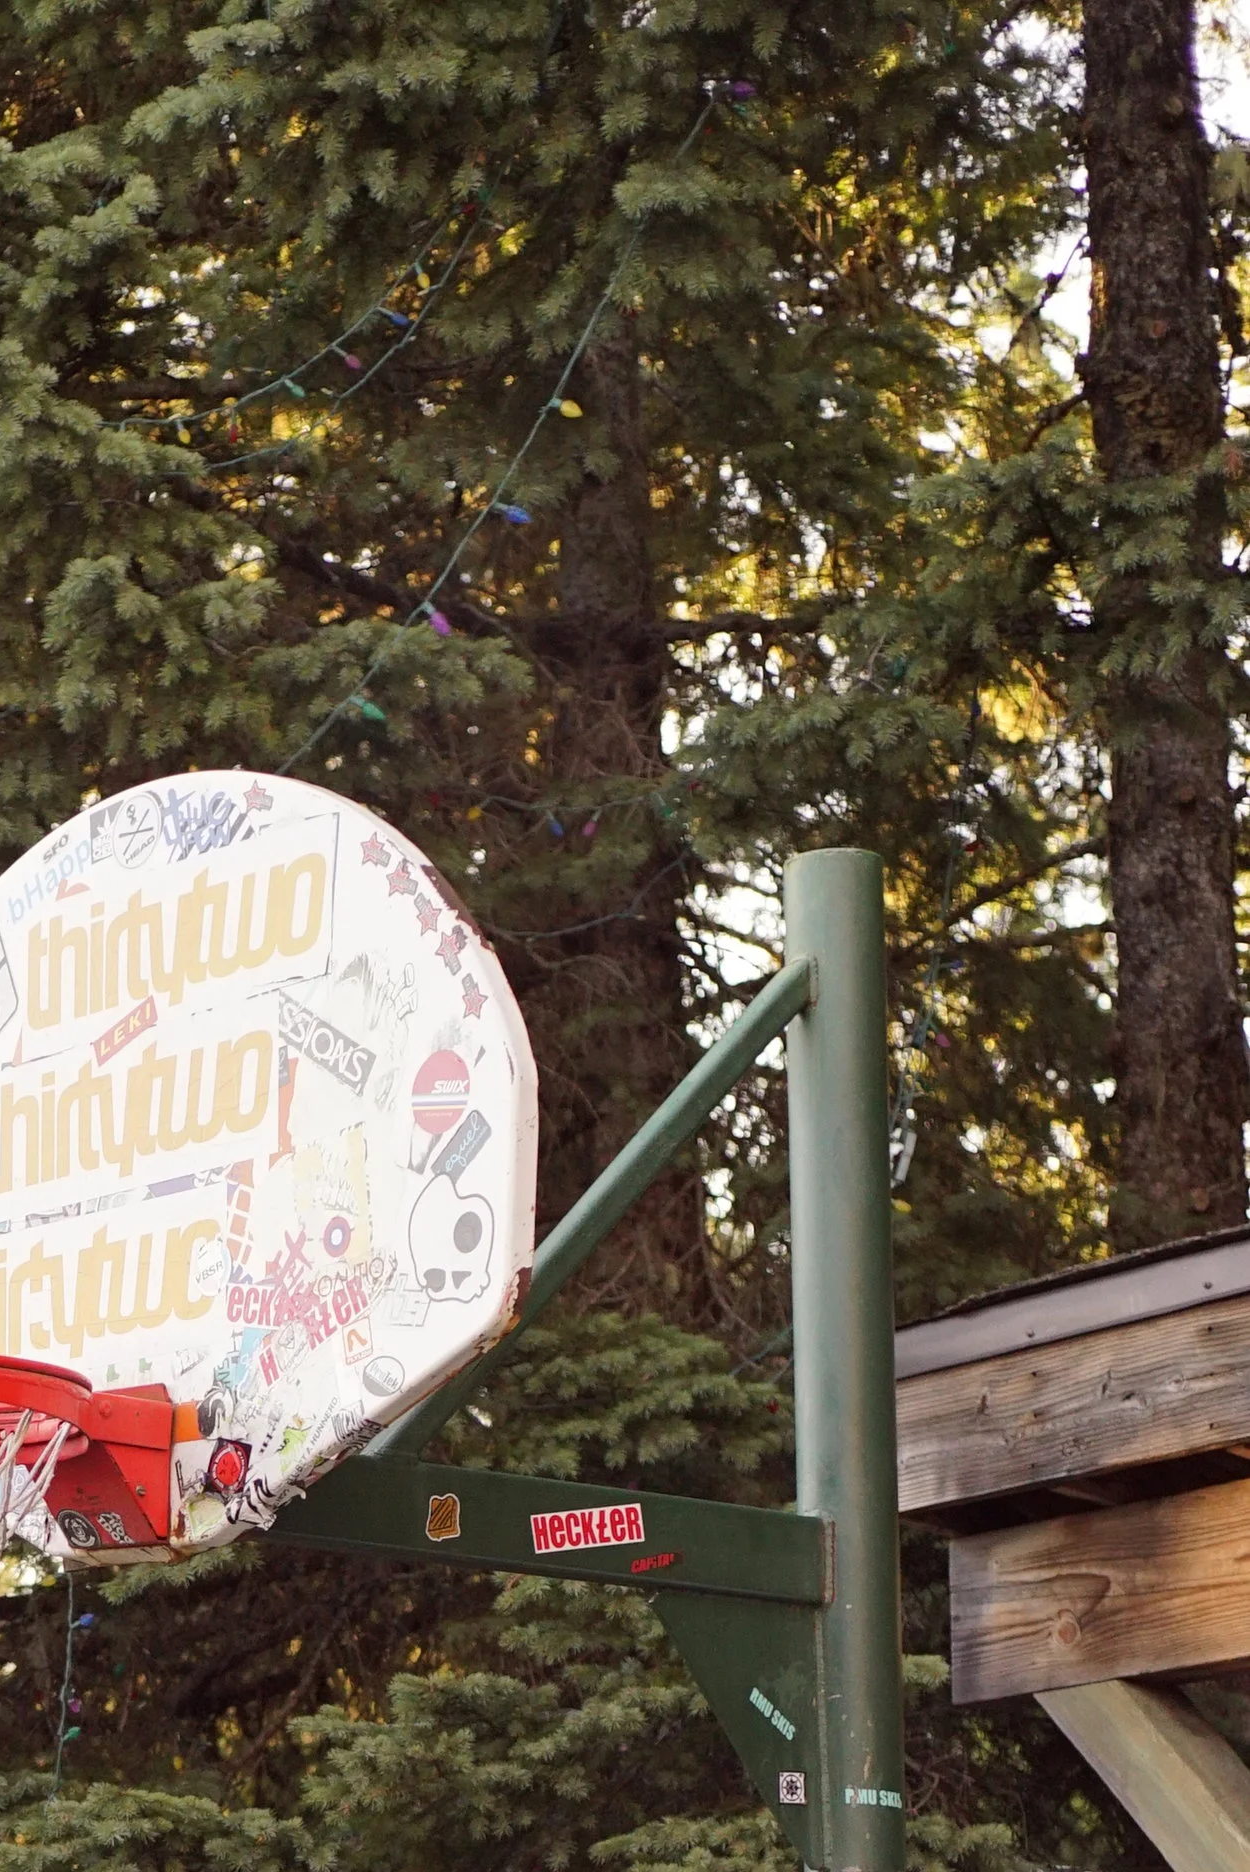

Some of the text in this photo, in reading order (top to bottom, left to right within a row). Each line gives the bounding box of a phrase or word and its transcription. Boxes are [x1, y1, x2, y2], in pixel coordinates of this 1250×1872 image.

[8, 839, 91, 926] bHapp
[125, 835, 156, 865] HEAD
[27, 852, 328, 1030] thirtytwo
[100, 1003, 151, 1058] LEKI
[279, 1001, 369, 1083] SSIONS
[771, 1709, 796, 1741] SKIS
